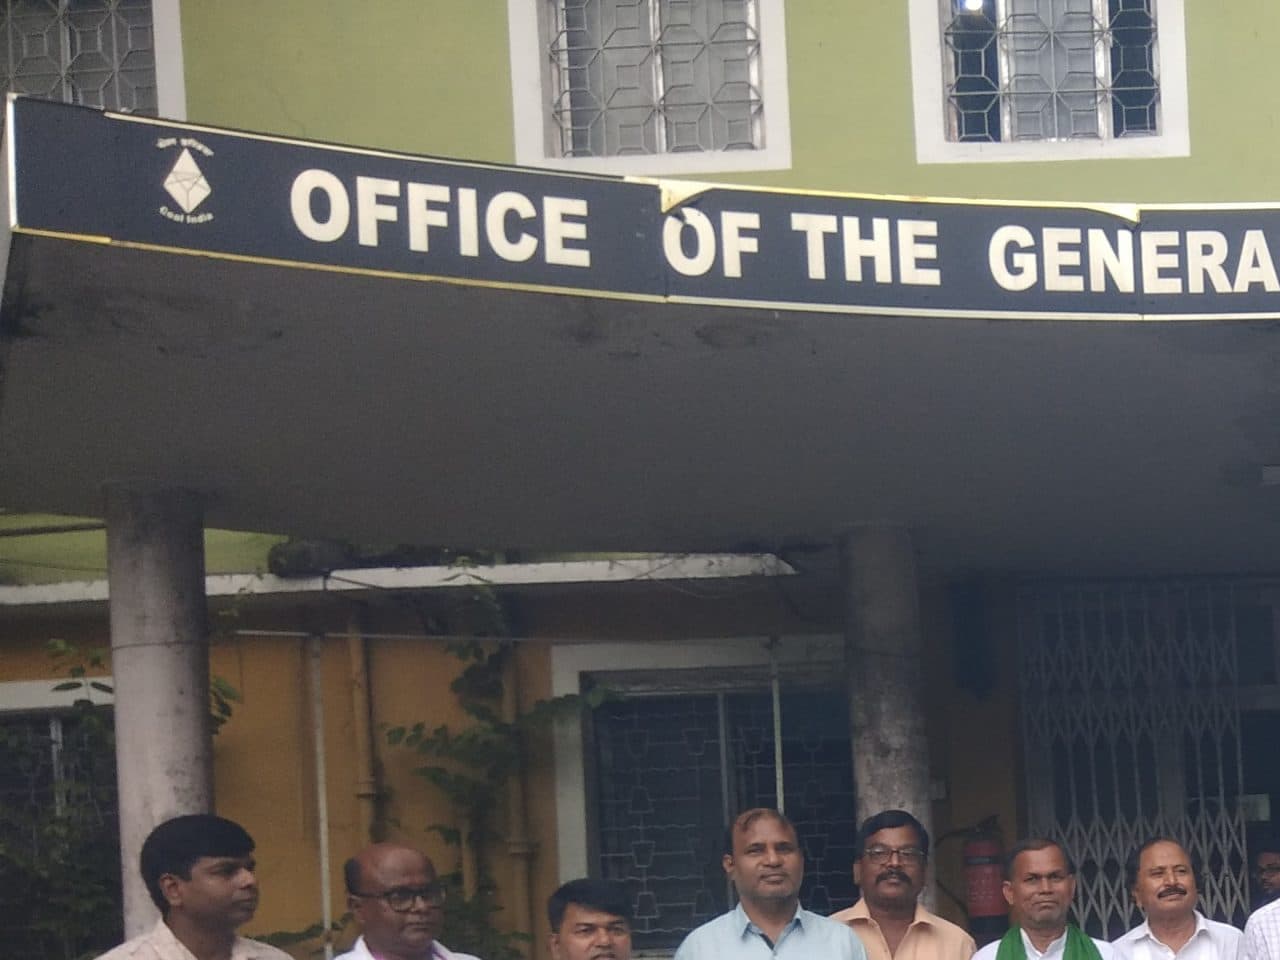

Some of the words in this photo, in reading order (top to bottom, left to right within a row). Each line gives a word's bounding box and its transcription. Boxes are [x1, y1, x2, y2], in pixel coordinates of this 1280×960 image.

[290, 168, 591, 268] OFFICE
[662, 205, 761, 279] OF
[791, 212, 941, 287] THE
